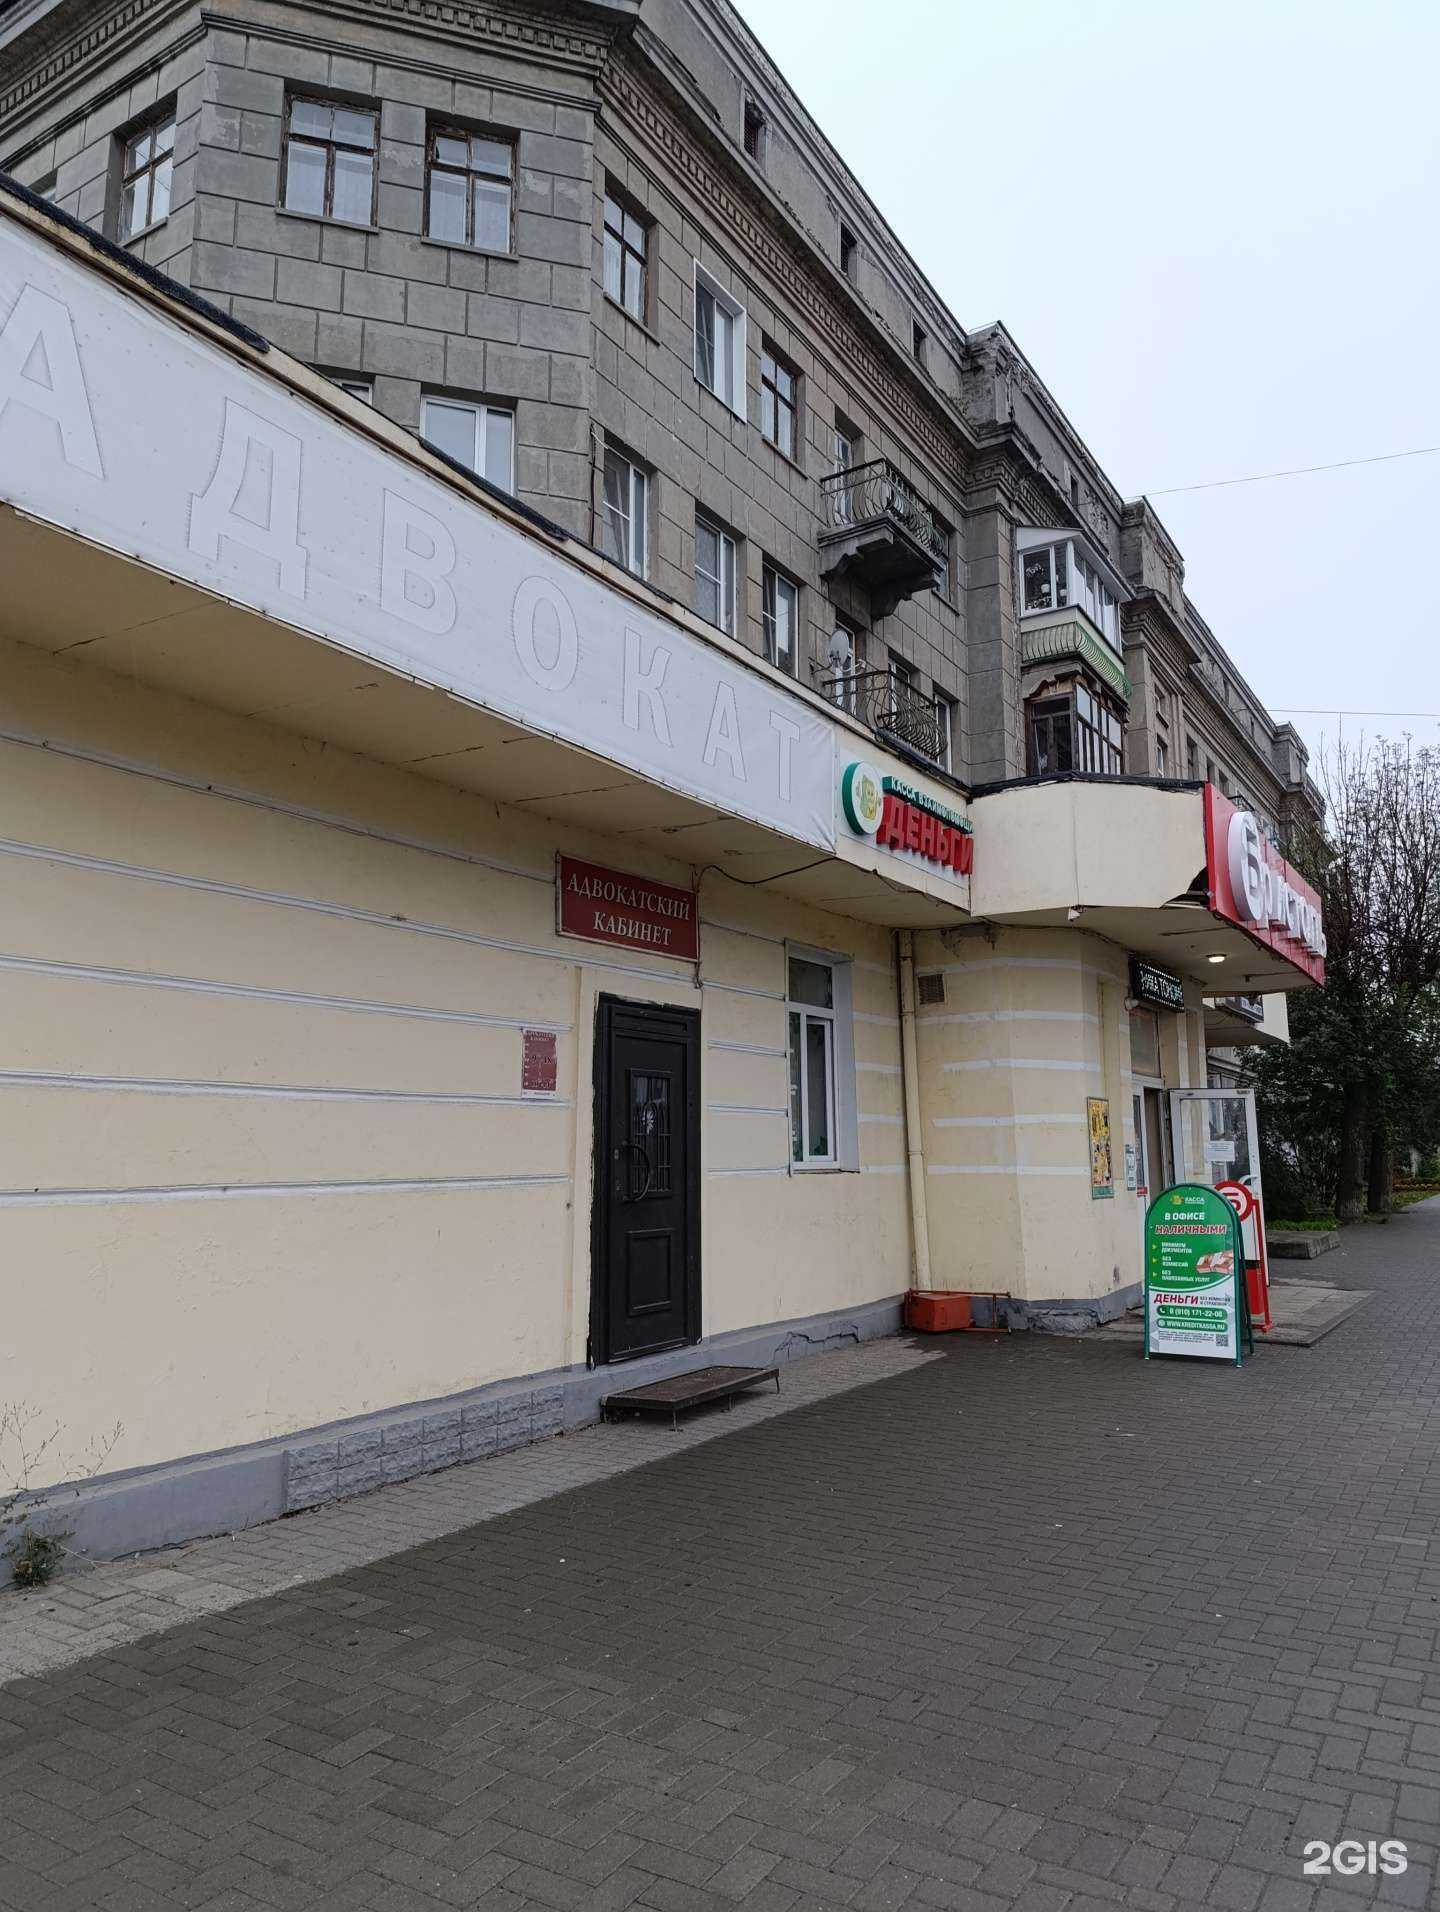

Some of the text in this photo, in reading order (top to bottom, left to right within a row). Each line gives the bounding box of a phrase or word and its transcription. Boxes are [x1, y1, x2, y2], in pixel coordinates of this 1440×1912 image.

[0, 281, 800, 803] АДВОКАТ
[885, 774, 918, 802] КАССА
[877, 795, 974, 875] ДЕНЬГИ
[566, 873, 690, 920] АДВОКАТСКИЙ
[593, 911, 672, 945] КАБИНЕТ
[1155, 1224, 1227, 1235] НАЛИЧНЫМИ
[1164, 1212, 1205, 1221] В ОФИСЕ
[1154, 1293, 1199, 1305] ДЕНЬГИ
